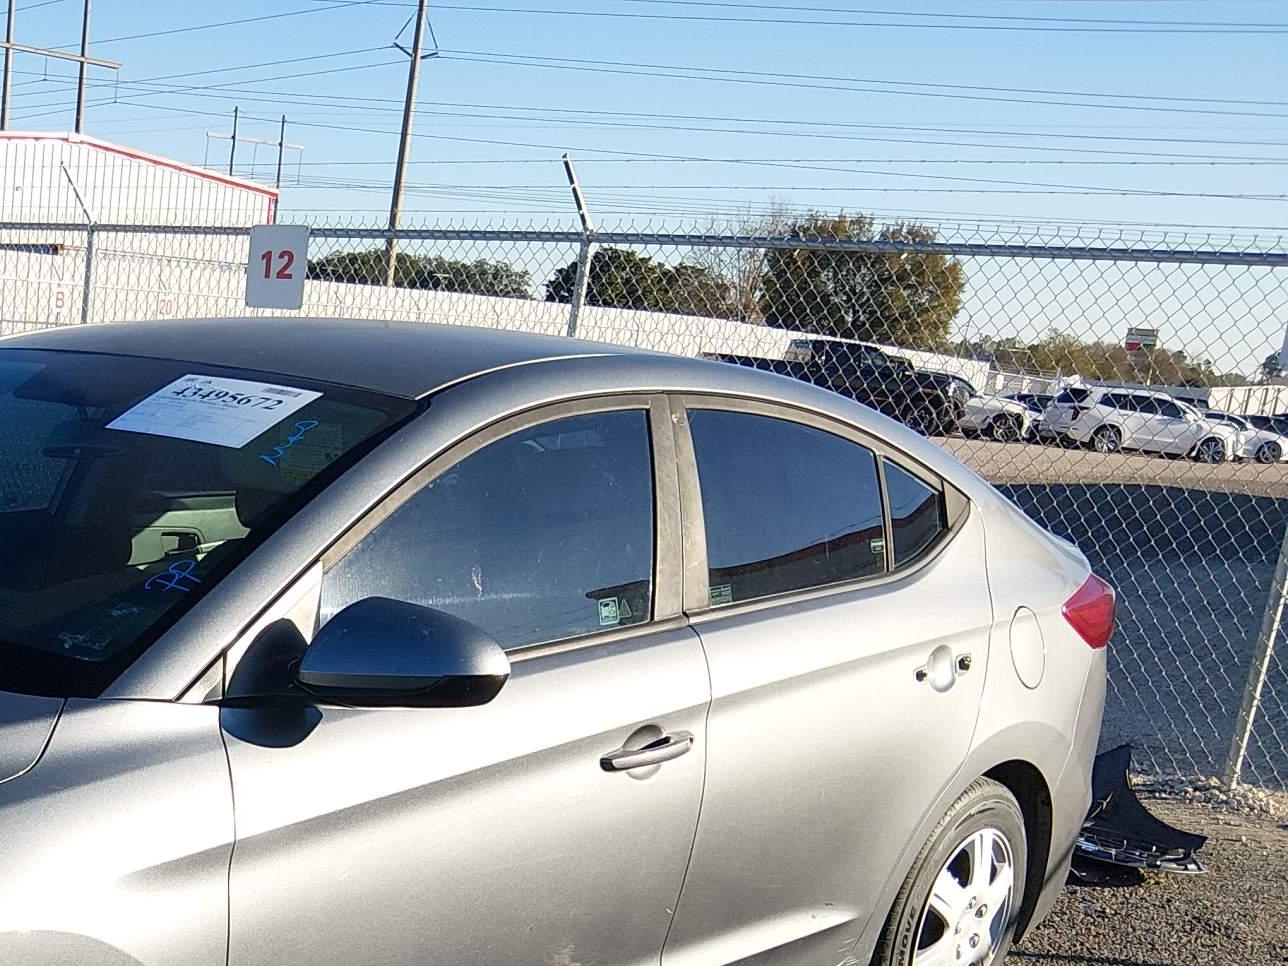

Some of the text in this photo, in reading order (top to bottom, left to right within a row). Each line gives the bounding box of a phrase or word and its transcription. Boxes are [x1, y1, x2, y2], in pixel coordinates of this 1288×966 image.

[261, 250, 295, 280] 12
[55, 291, 65, 309] B
[172, 386, 285, 411] 43495672
